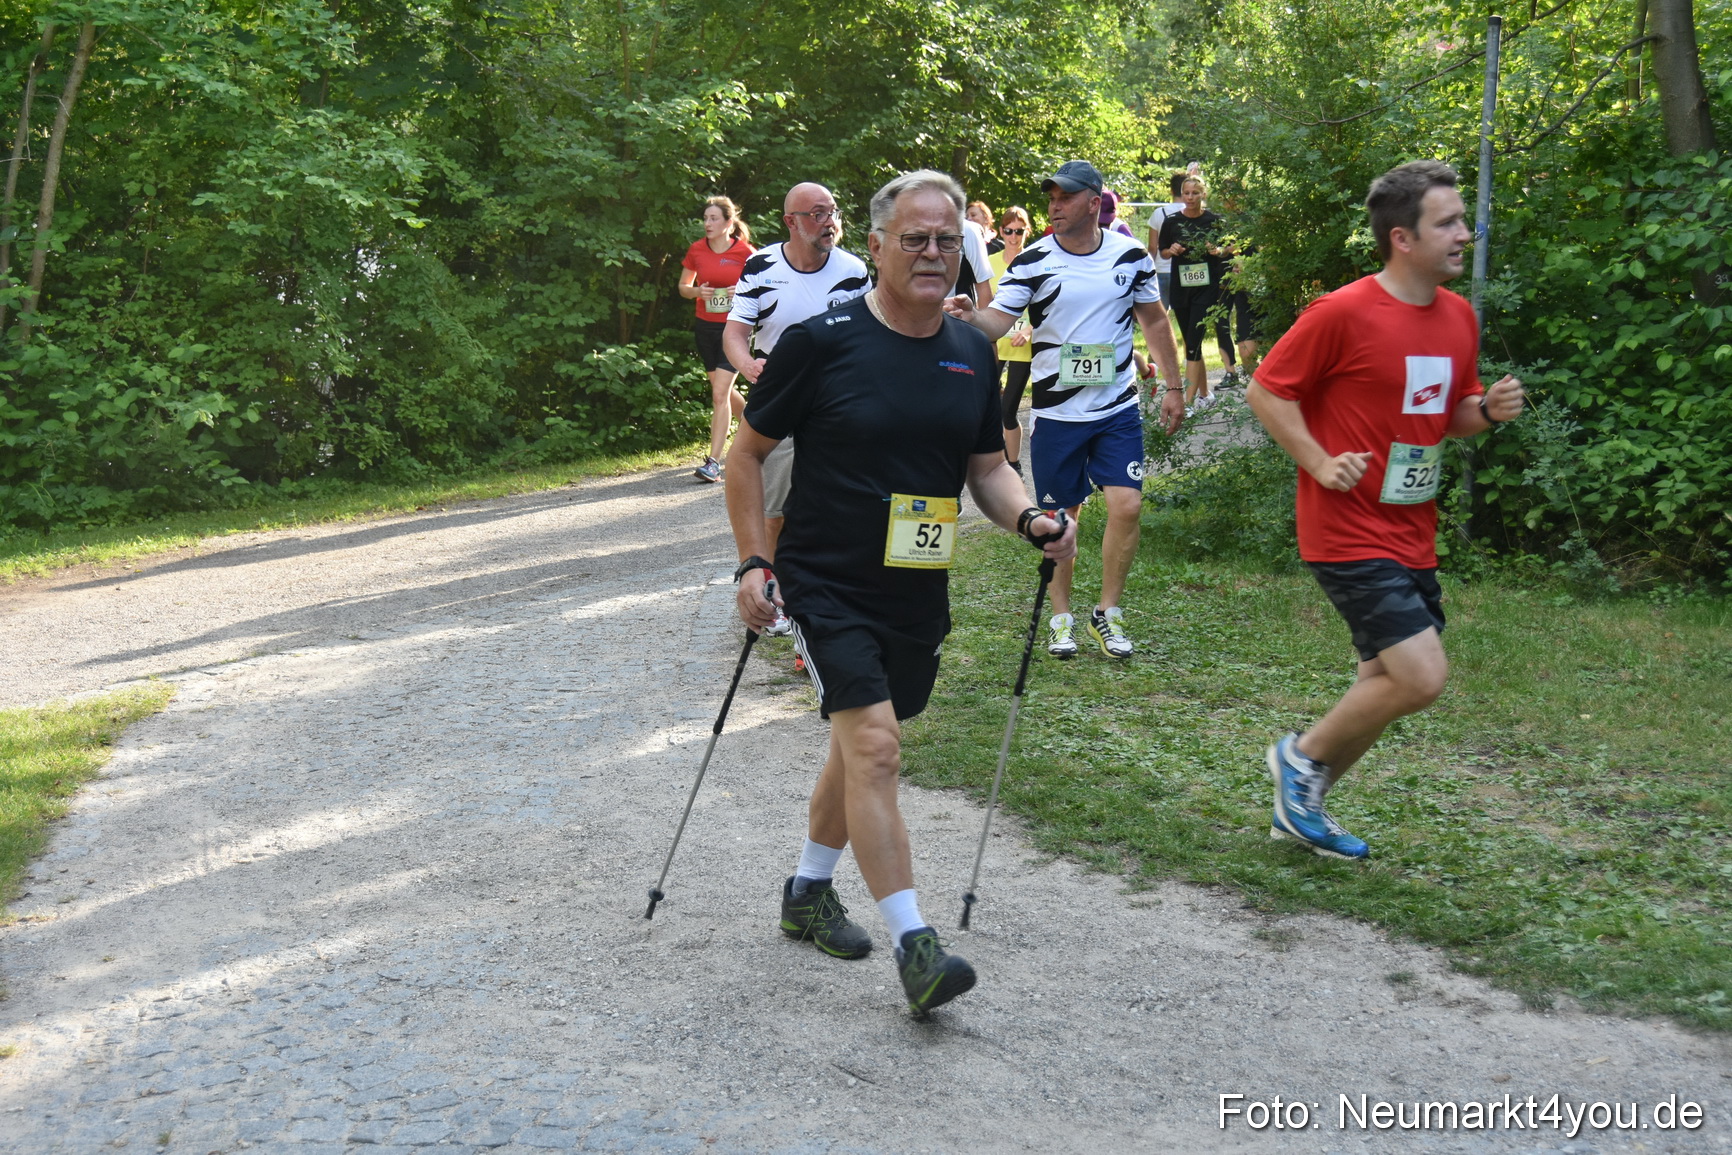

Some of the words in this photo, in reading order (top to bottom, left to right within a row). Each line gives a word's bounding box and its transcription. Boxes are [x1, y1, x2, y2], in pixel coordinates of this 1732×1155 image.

[1183, 271, 1205, 281] 1868
[1071, 358, 1101, 374] 791
[915, 523, 942, 549] 52
